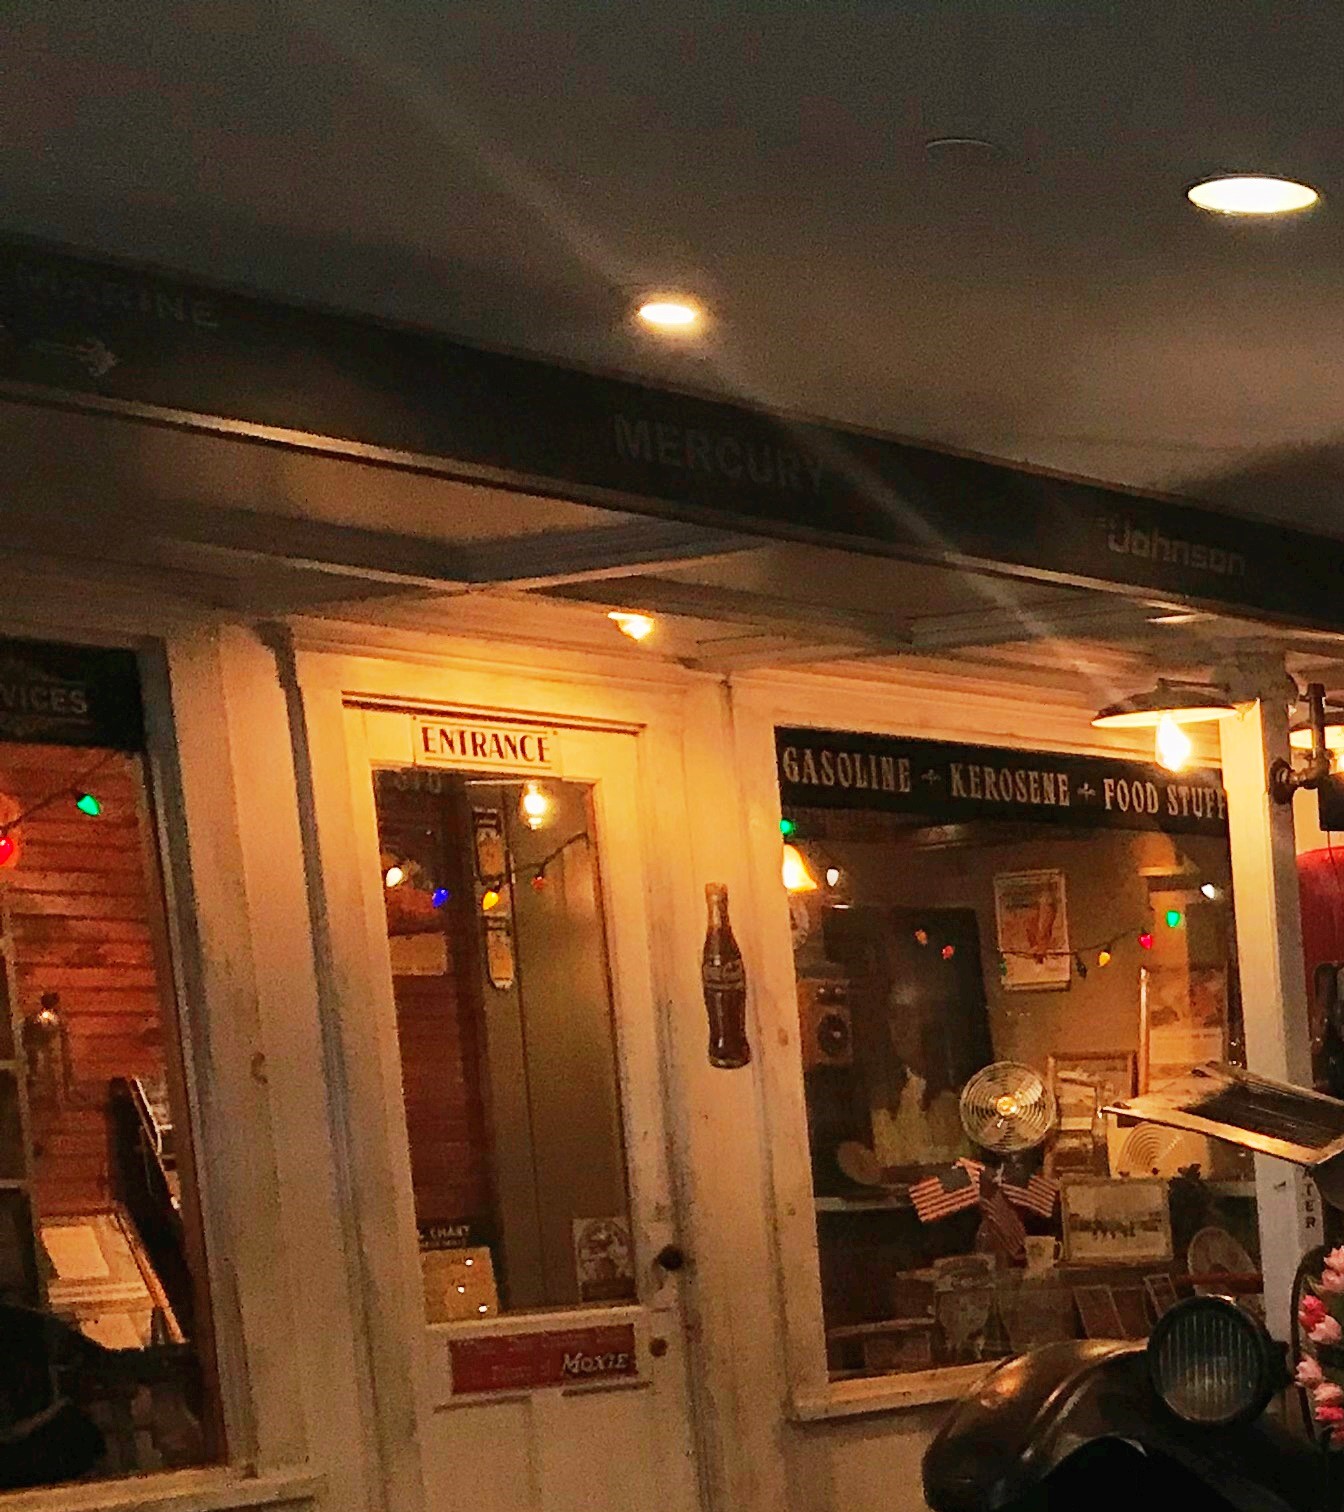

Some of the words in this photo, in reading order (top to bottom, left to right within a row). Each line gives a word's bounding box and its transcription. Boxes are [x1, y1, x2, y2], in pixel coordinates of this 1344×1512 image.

[614, 414, 823, 495] MERCURY
[1106, 514, 1246, 577] Johnson
[421, 726, 553, 763] ENTRANCE
[782, 745, 912, 792] GASOLINE
[950, 761, 1071, 807] KEROSENE
[1102, 777, 1159, 814] FOOD
